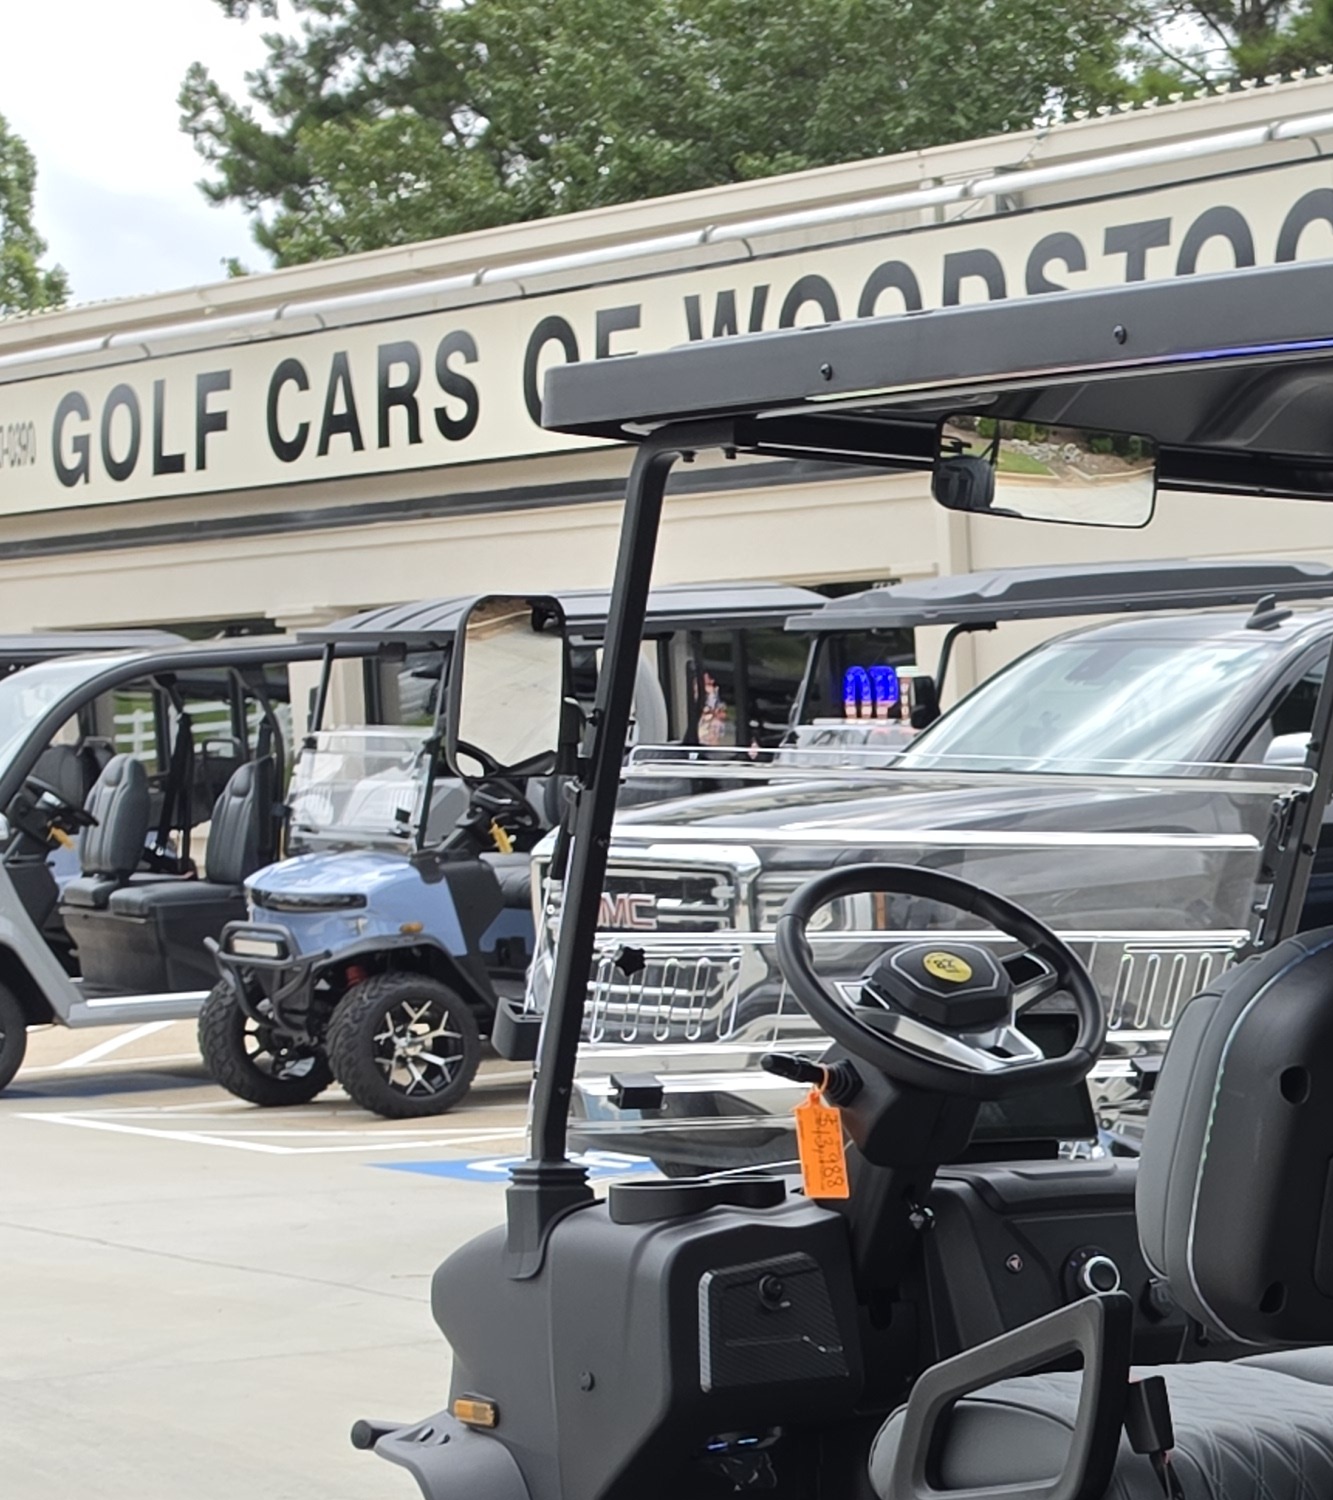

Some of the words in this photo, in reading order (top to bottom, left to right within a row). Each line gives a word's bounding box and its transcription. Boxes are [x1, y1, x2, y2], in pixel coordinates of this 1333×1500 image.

[52, 369, 232, 488] GOLF
[266, 330, 480, 463] CARS
[597, 891, 658, 930] MC
